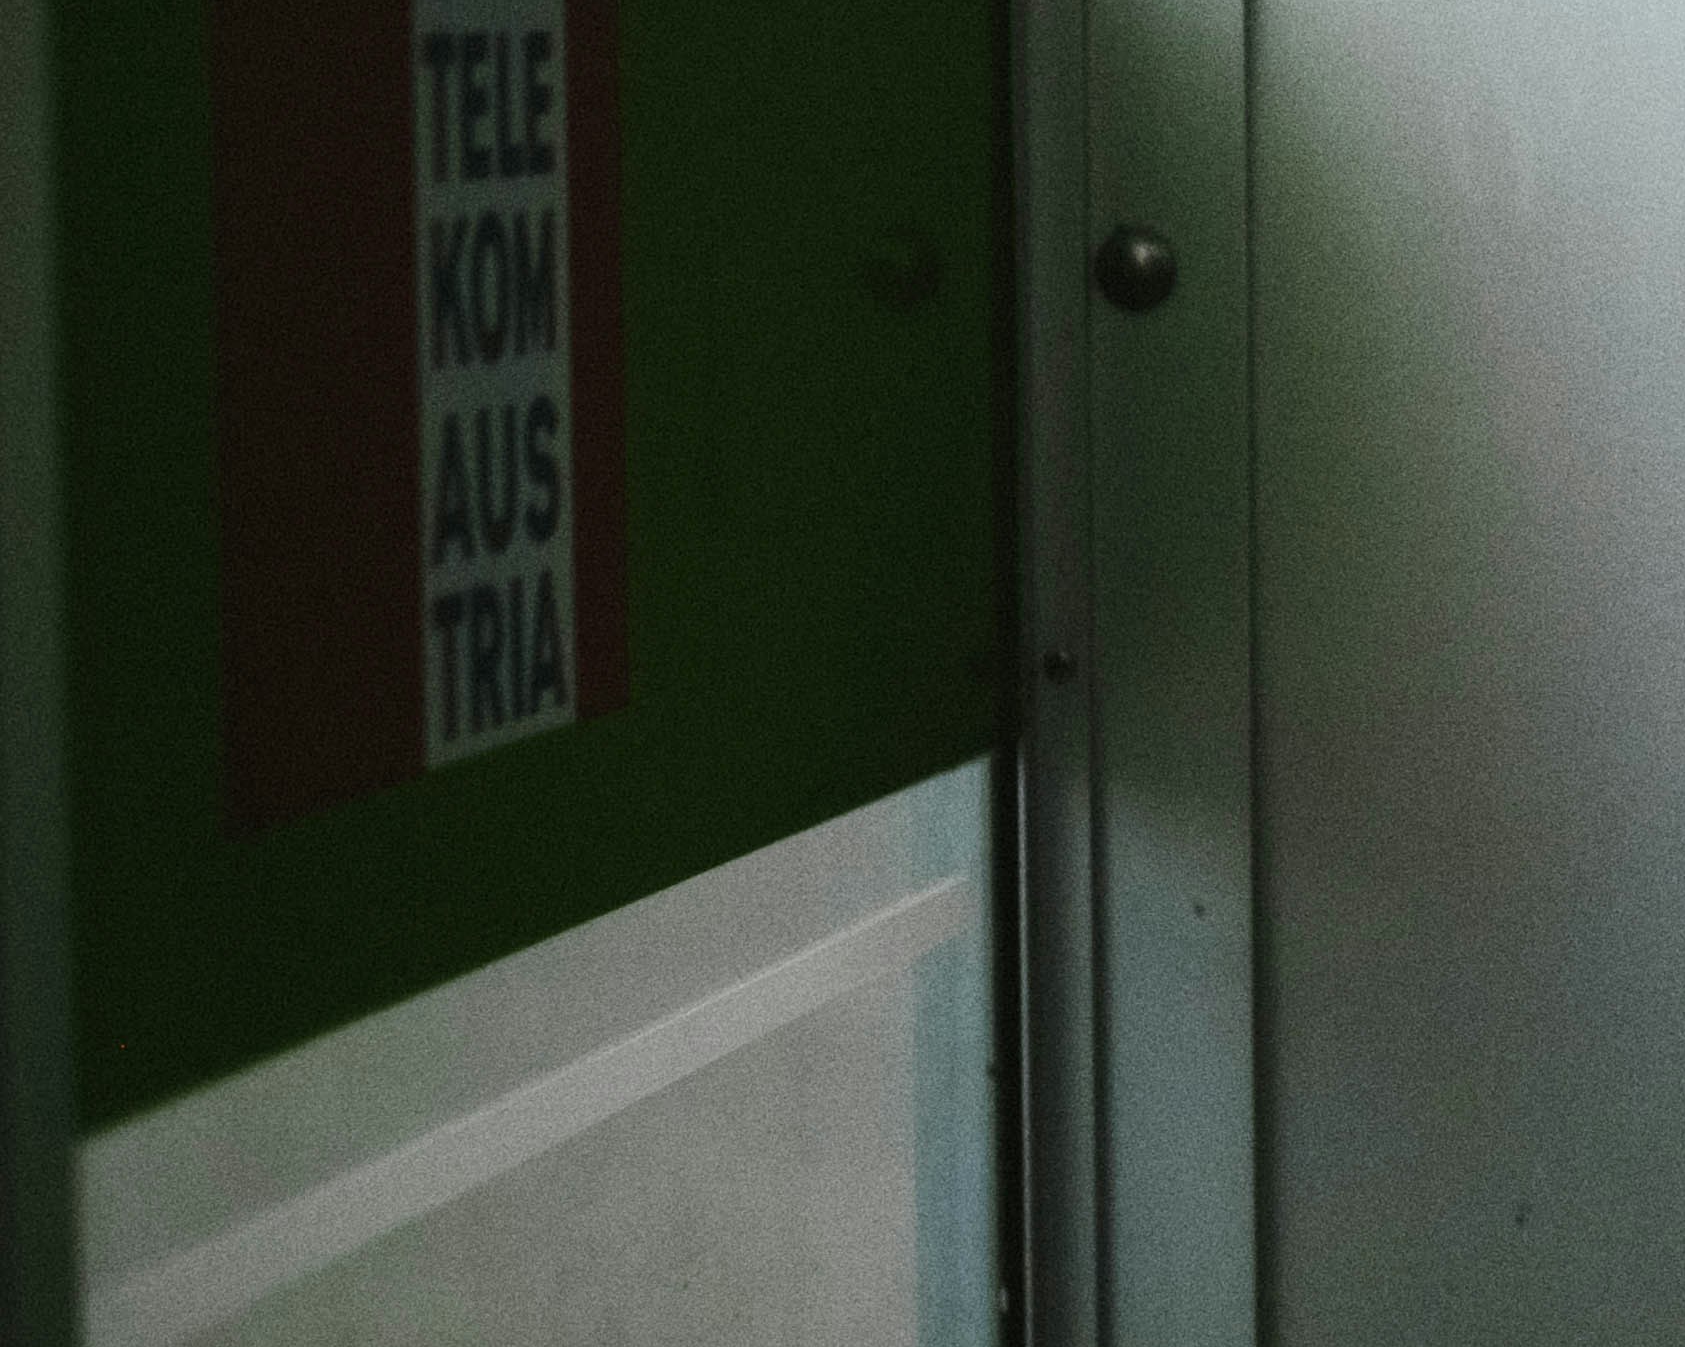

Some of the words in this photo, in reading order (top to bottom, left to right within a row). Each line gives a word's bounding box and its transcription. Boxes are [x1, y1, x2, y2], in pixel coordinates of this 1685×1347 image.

[424, 31, 556, 181] TELE
[430, 209, 557, 369] KOM
[432, 395, 561, 566] AUS
[432, 569, 566, 742] TRIA
